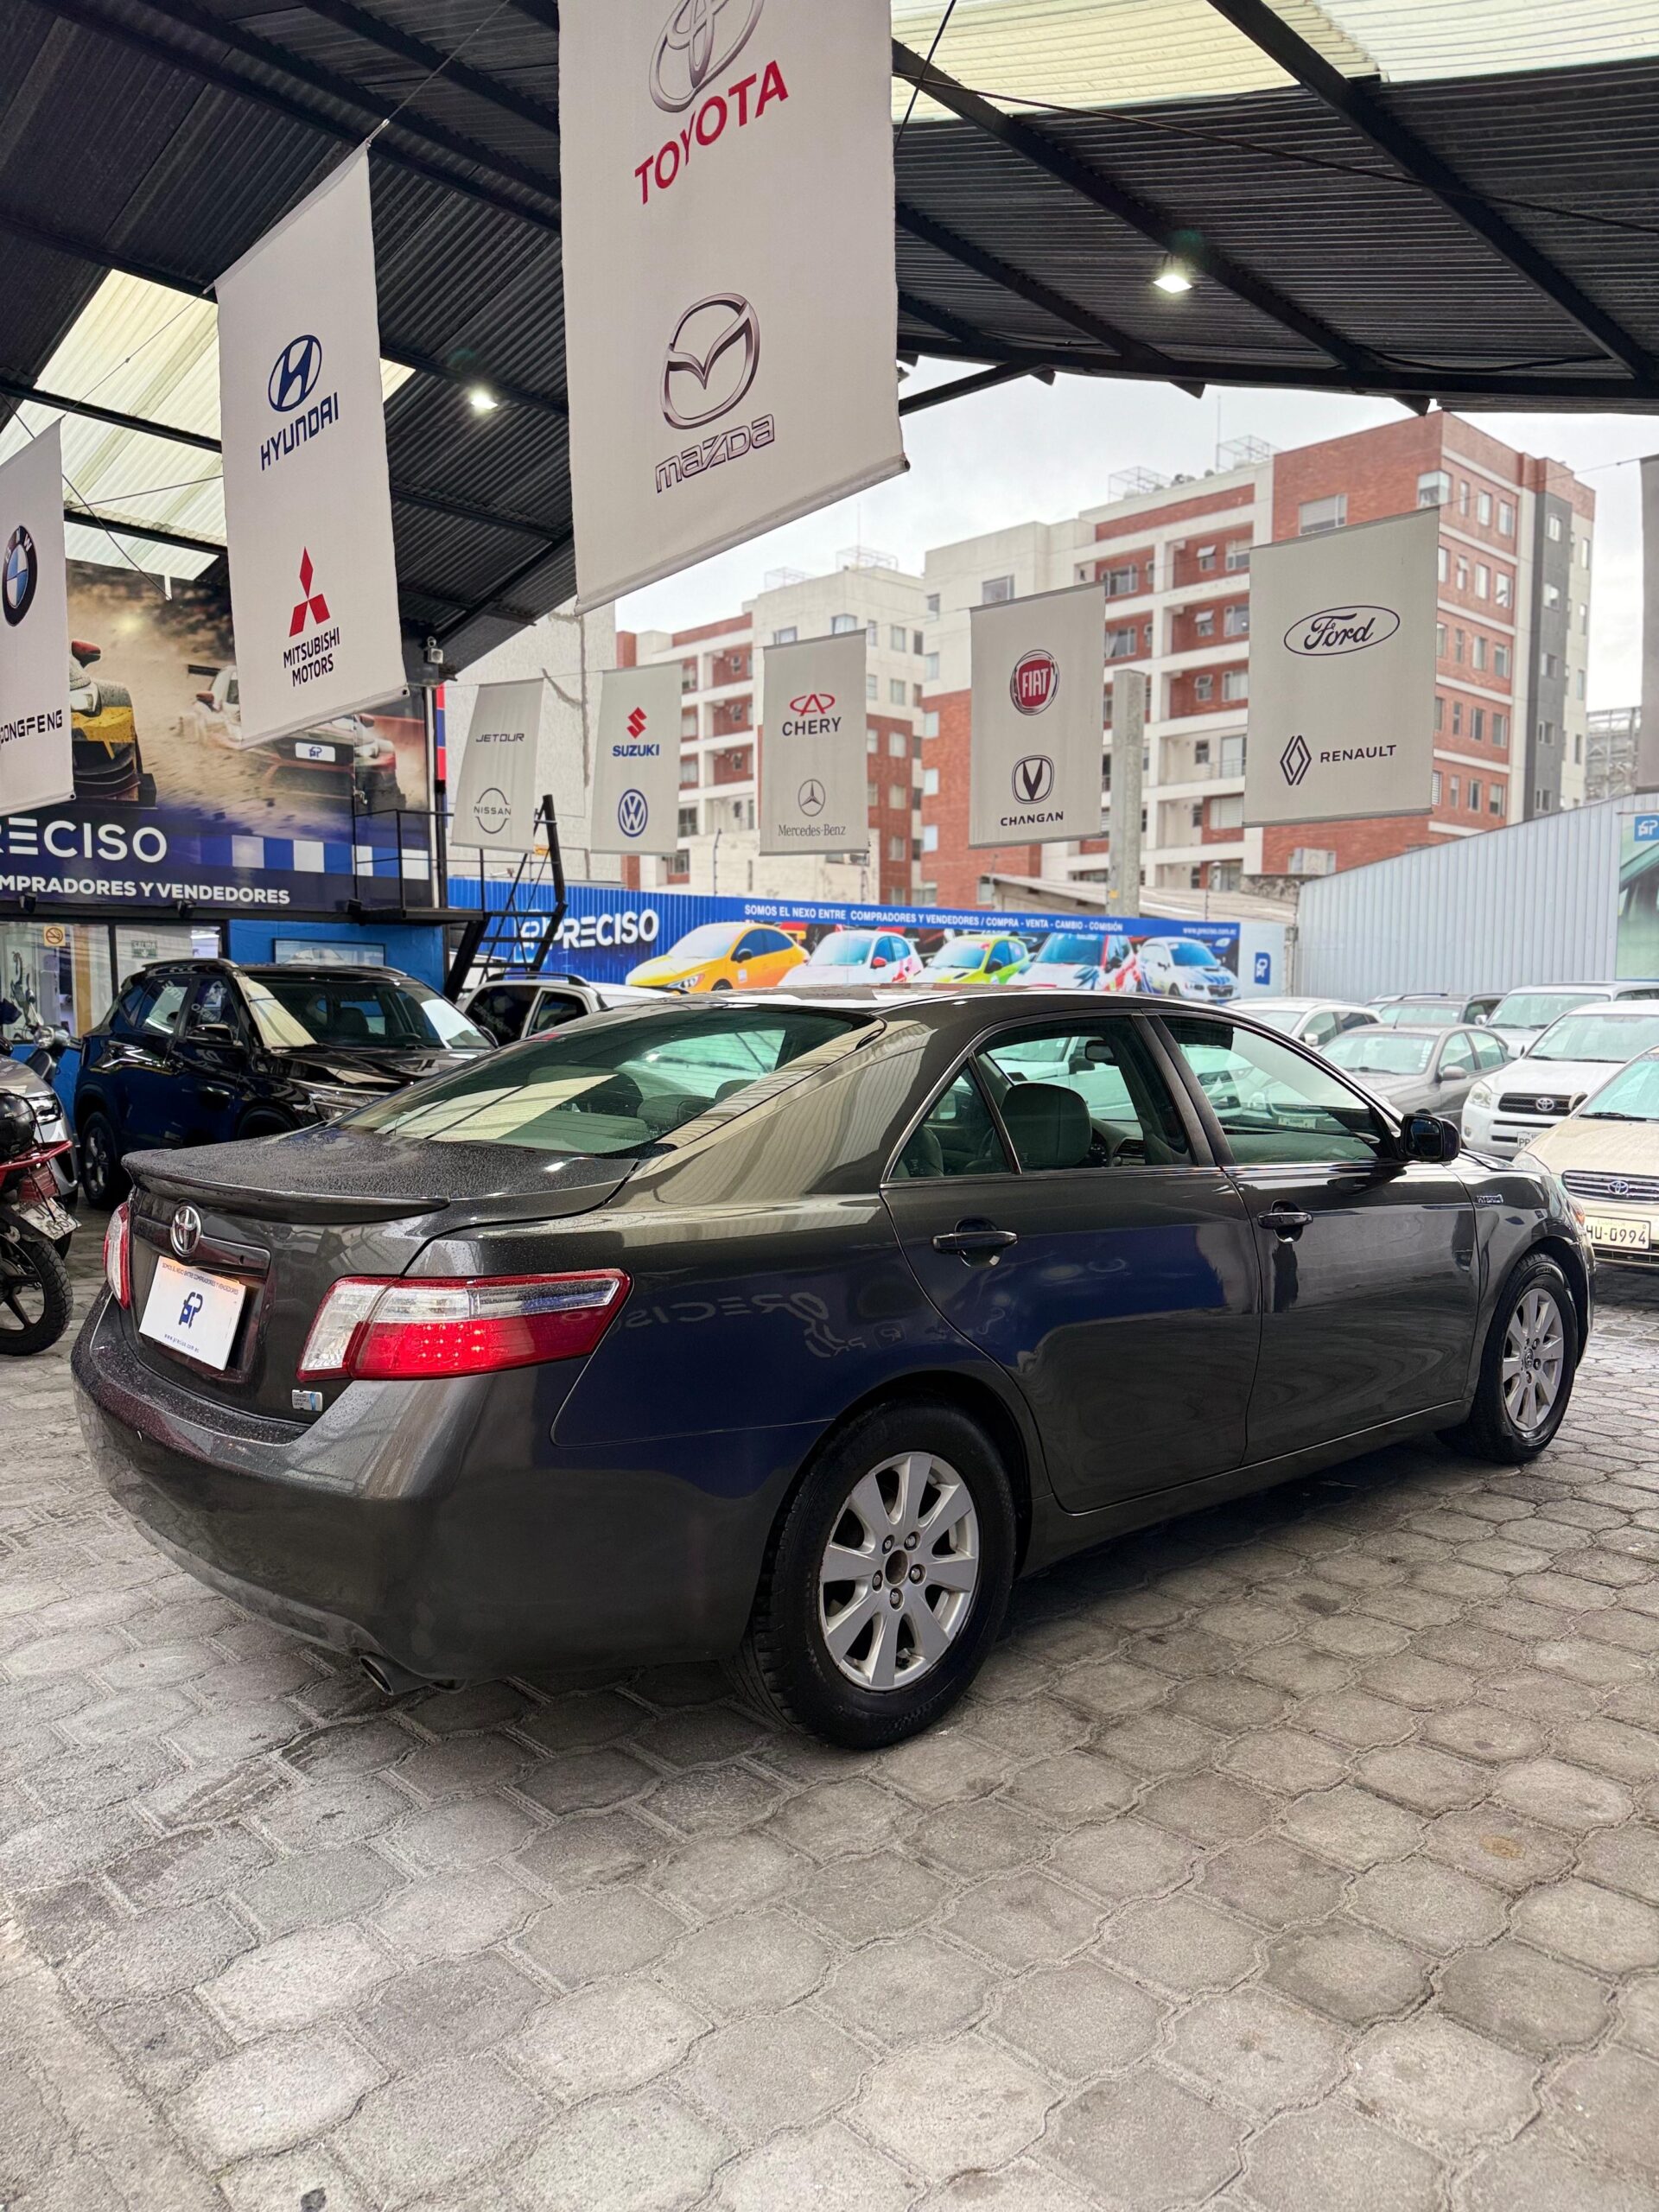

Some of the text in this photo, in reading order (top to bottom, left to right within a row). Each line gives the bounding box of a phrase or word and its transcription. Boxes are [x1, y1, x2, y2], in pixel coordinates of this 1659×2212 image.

[634, 60, 788, 205] TOYOTA
[261, 391, 339, 471] HYUNDAI
[1304, 613, 1376, 650] Ford
[283, 626, 340, 668] MITSUBISHI
[292, 653, 334, 687] MOTORS
[1021, 667, 1049, 698] FIAT
[475, 733, 524, 742] JETOUR
[782, 716, 842, 736] CHERY
[612, 744, 660, 757] SUZUKI
[1319, 744, 1397, 763] RENAULT
[474, 805, 512, 816] NISSAN
[1001, 810, 1064, 826] CHANGAN
[0, 817, 168, 863] ECISO
[778, 823, 846, 836] Mercedes-Benz
[139, 881, 155, 897] Y
[156, 882, 290, 905] VENDEDORES
[744, 905, 778, 916] SOMOS
[779, 906, 791, 917] EL
[792, 907, 817, 918] NEXO
[818, 909, 847, 920] ENTRE
[850, 911, 917, 924] COMPRADORES
[918, 913, 925, 924] Y
[926, 914, 980, 926] VENDEDORES
[986, 916, 1019, 928] COMPRA
[1026, 918, 1049, 929] VENTA
[1055, 919, 1083, 931] CAMBIO
